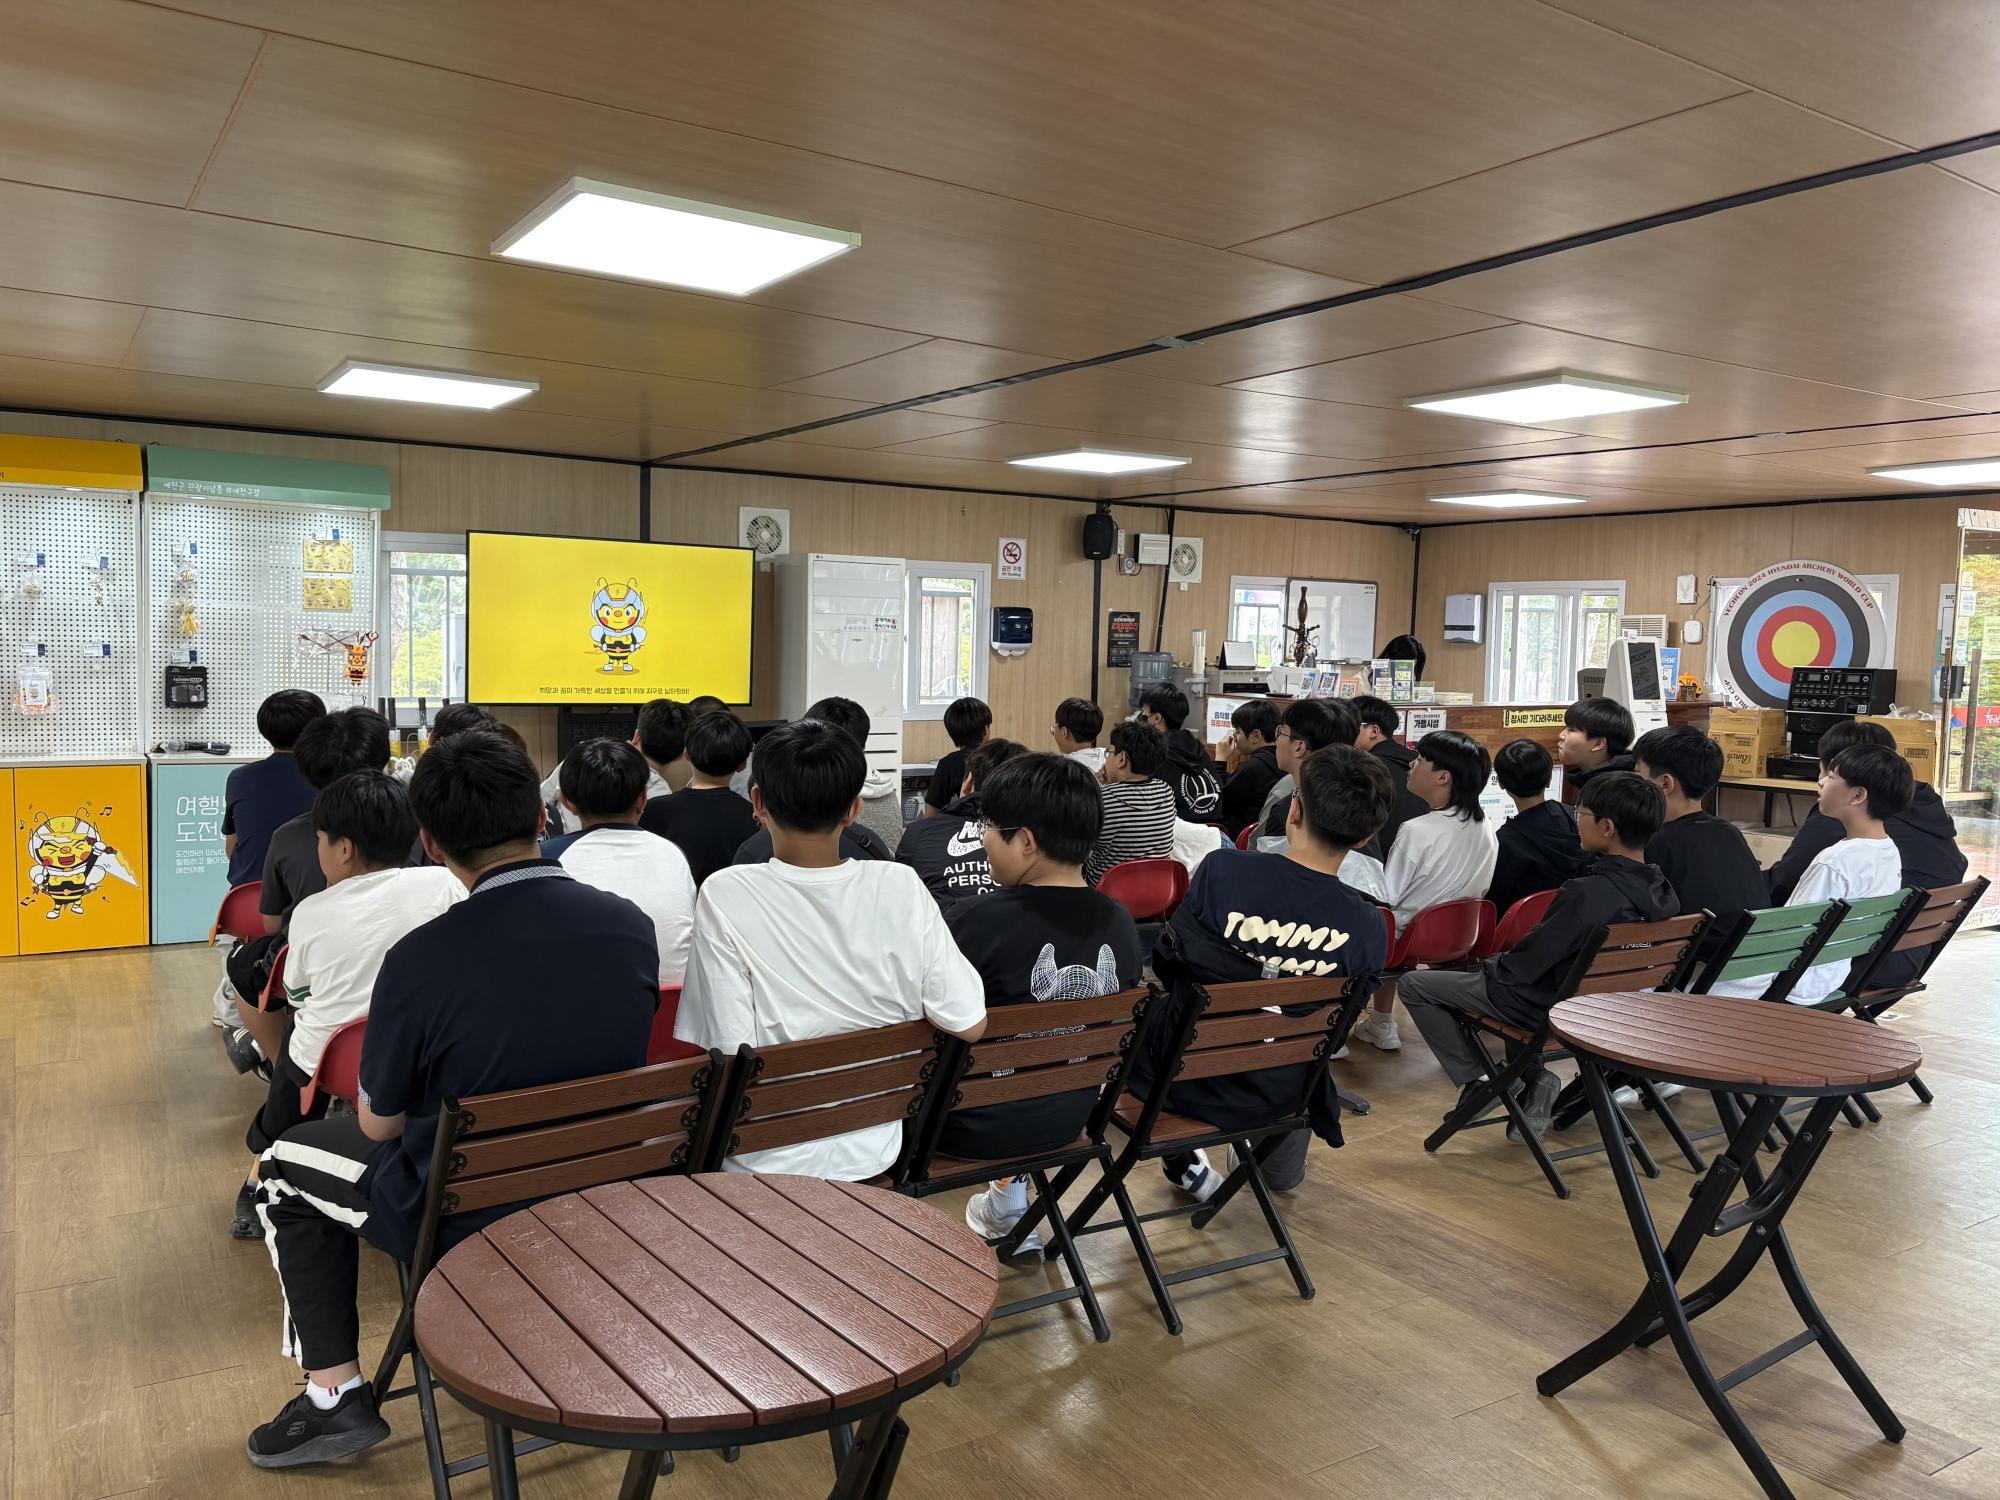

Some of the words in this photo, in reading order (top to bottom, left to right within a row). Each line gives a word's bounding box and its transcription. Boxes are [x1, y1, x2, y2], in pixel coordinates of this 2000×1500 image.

[1723, 585, 1748, 616] YECHEON
[1748, 572, 1766, 587] 2024
[1767, 563, 1800, 576] HYUNDAI
[1802, 562, 1837, 576] ARCHERY
[1837, 571, 1862, 593] WORLD
[1861, 593, 1874, 609] CUP
[1413, 719, 1440, 729] 가맹시설
[1529, 713, 1564, 723] 기다려주세요
[1223, 911, 1350, 952] TOMMY
